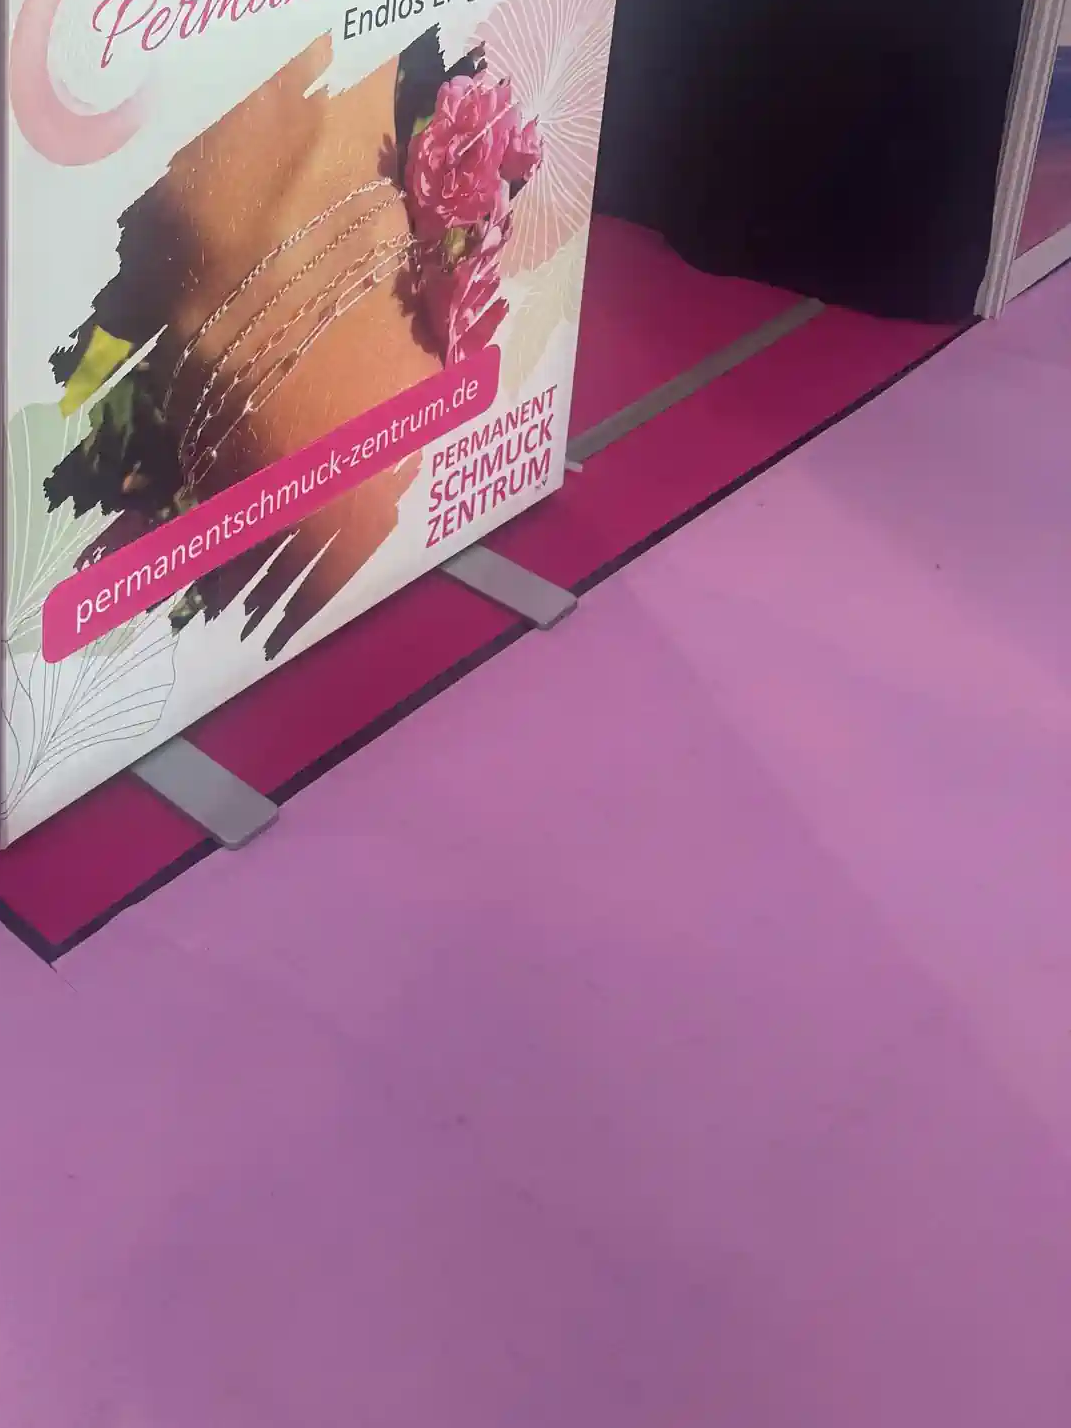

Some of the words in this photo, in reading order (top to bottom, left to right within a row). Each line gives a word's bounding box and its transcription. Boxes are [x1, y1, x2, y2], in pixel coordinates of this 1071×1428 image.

[428, 413, 555, 513] SCHMUCK
[432, 384, 558, 478] PERMANENT
[76, 377, 479, 633] permanentschmuck-zentrum.de
[425, 447, 551, 549] ZENTRUM
